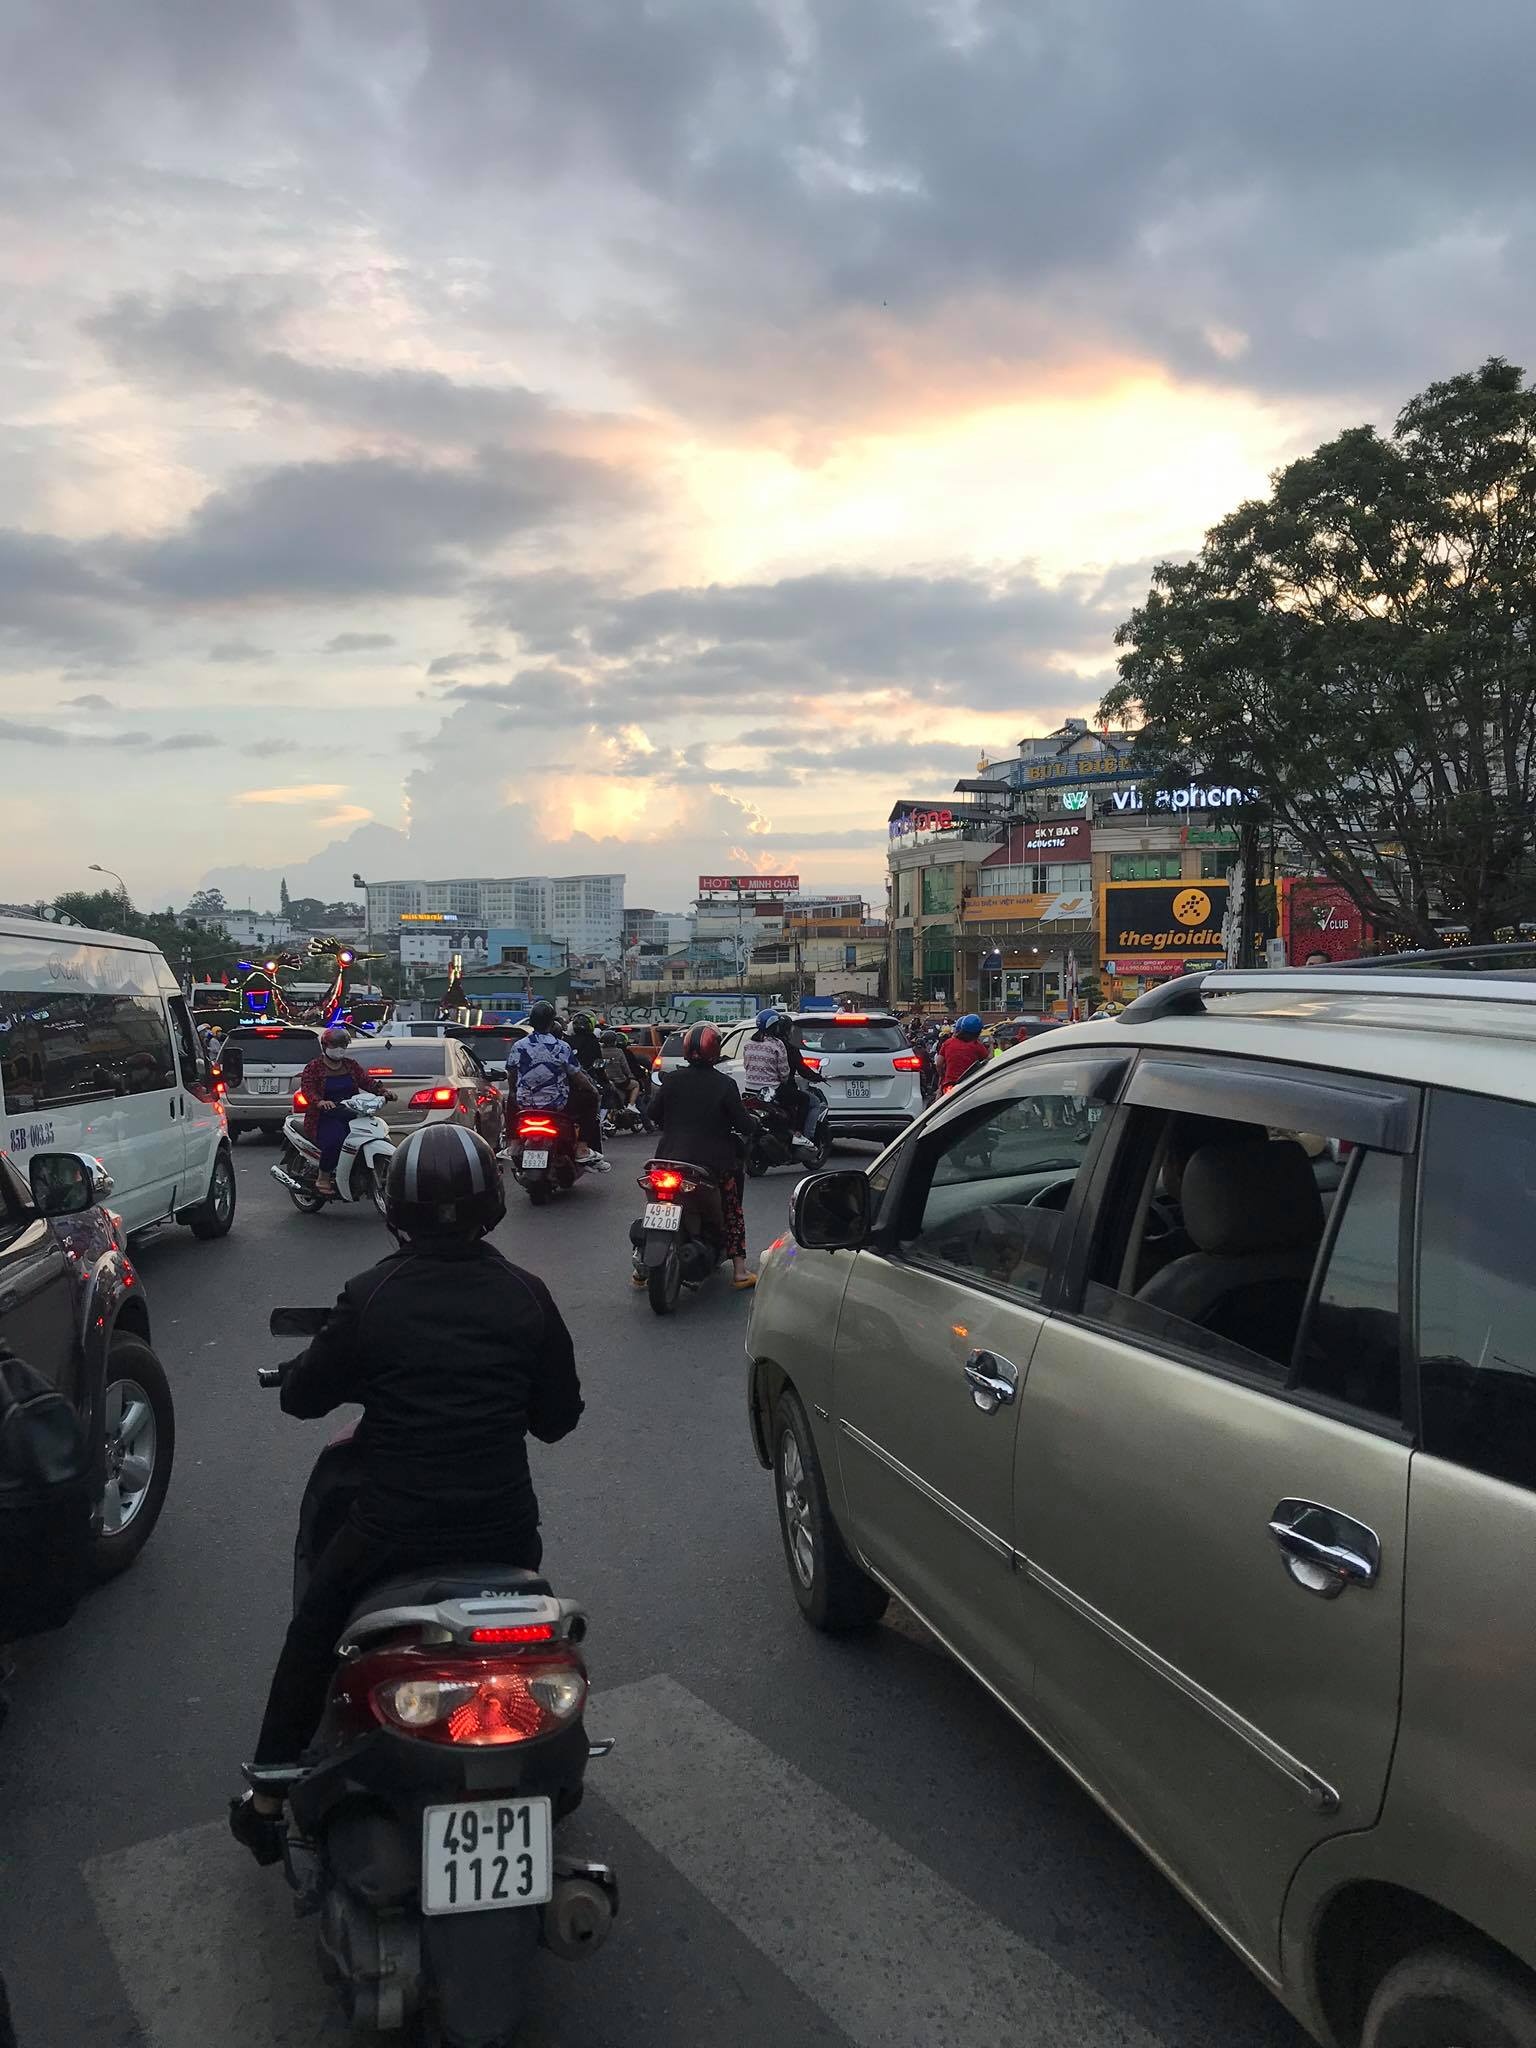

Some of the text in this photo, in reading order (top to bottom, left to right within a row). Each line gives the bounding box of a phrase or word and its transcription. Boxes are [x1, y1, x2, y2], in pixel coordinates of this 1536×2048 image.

[1035, 826, 1079, 838] SKY BAR
[1027, 838, 1065, 848] ACOUSTIC
[703, 878, 745, 888] HOTL
[749, 879, 771, 888] MINH
[1330, 919, 1349, 929] CLUB
[650, 1204, 676, 1217] 49-B1
[442, 1805, 531, 1855] 49-P1
[444, 1853, 533, 1904] 1123
